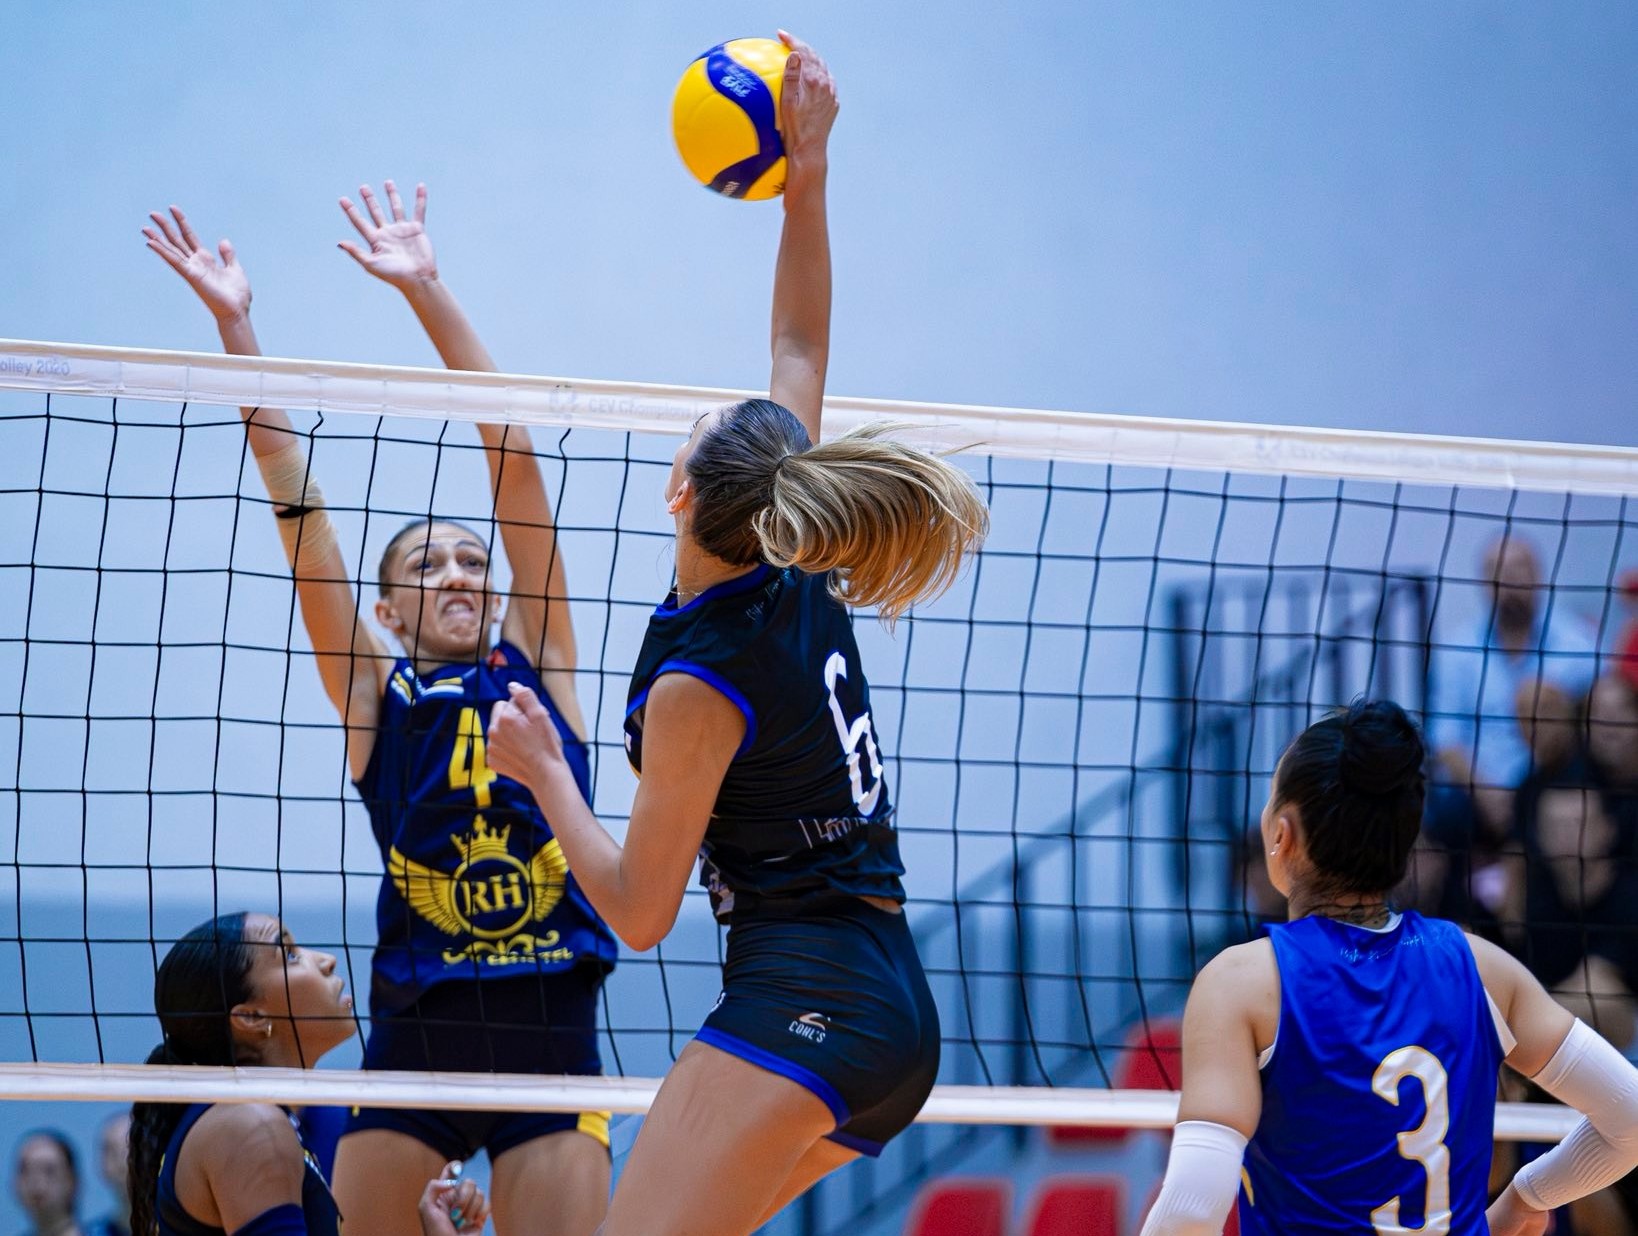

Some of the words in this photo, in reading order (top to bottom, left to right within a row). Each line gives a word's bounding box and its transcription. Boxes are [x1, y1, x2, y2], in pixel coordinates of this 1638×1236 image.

[36, 359, 71, 376] 2020
[449, 707, 497, 807] 4
[823, 651, 884, 816] 6
[461, 872, 525, 916] RH
[1370, 1045, 1452, 1236] 3
